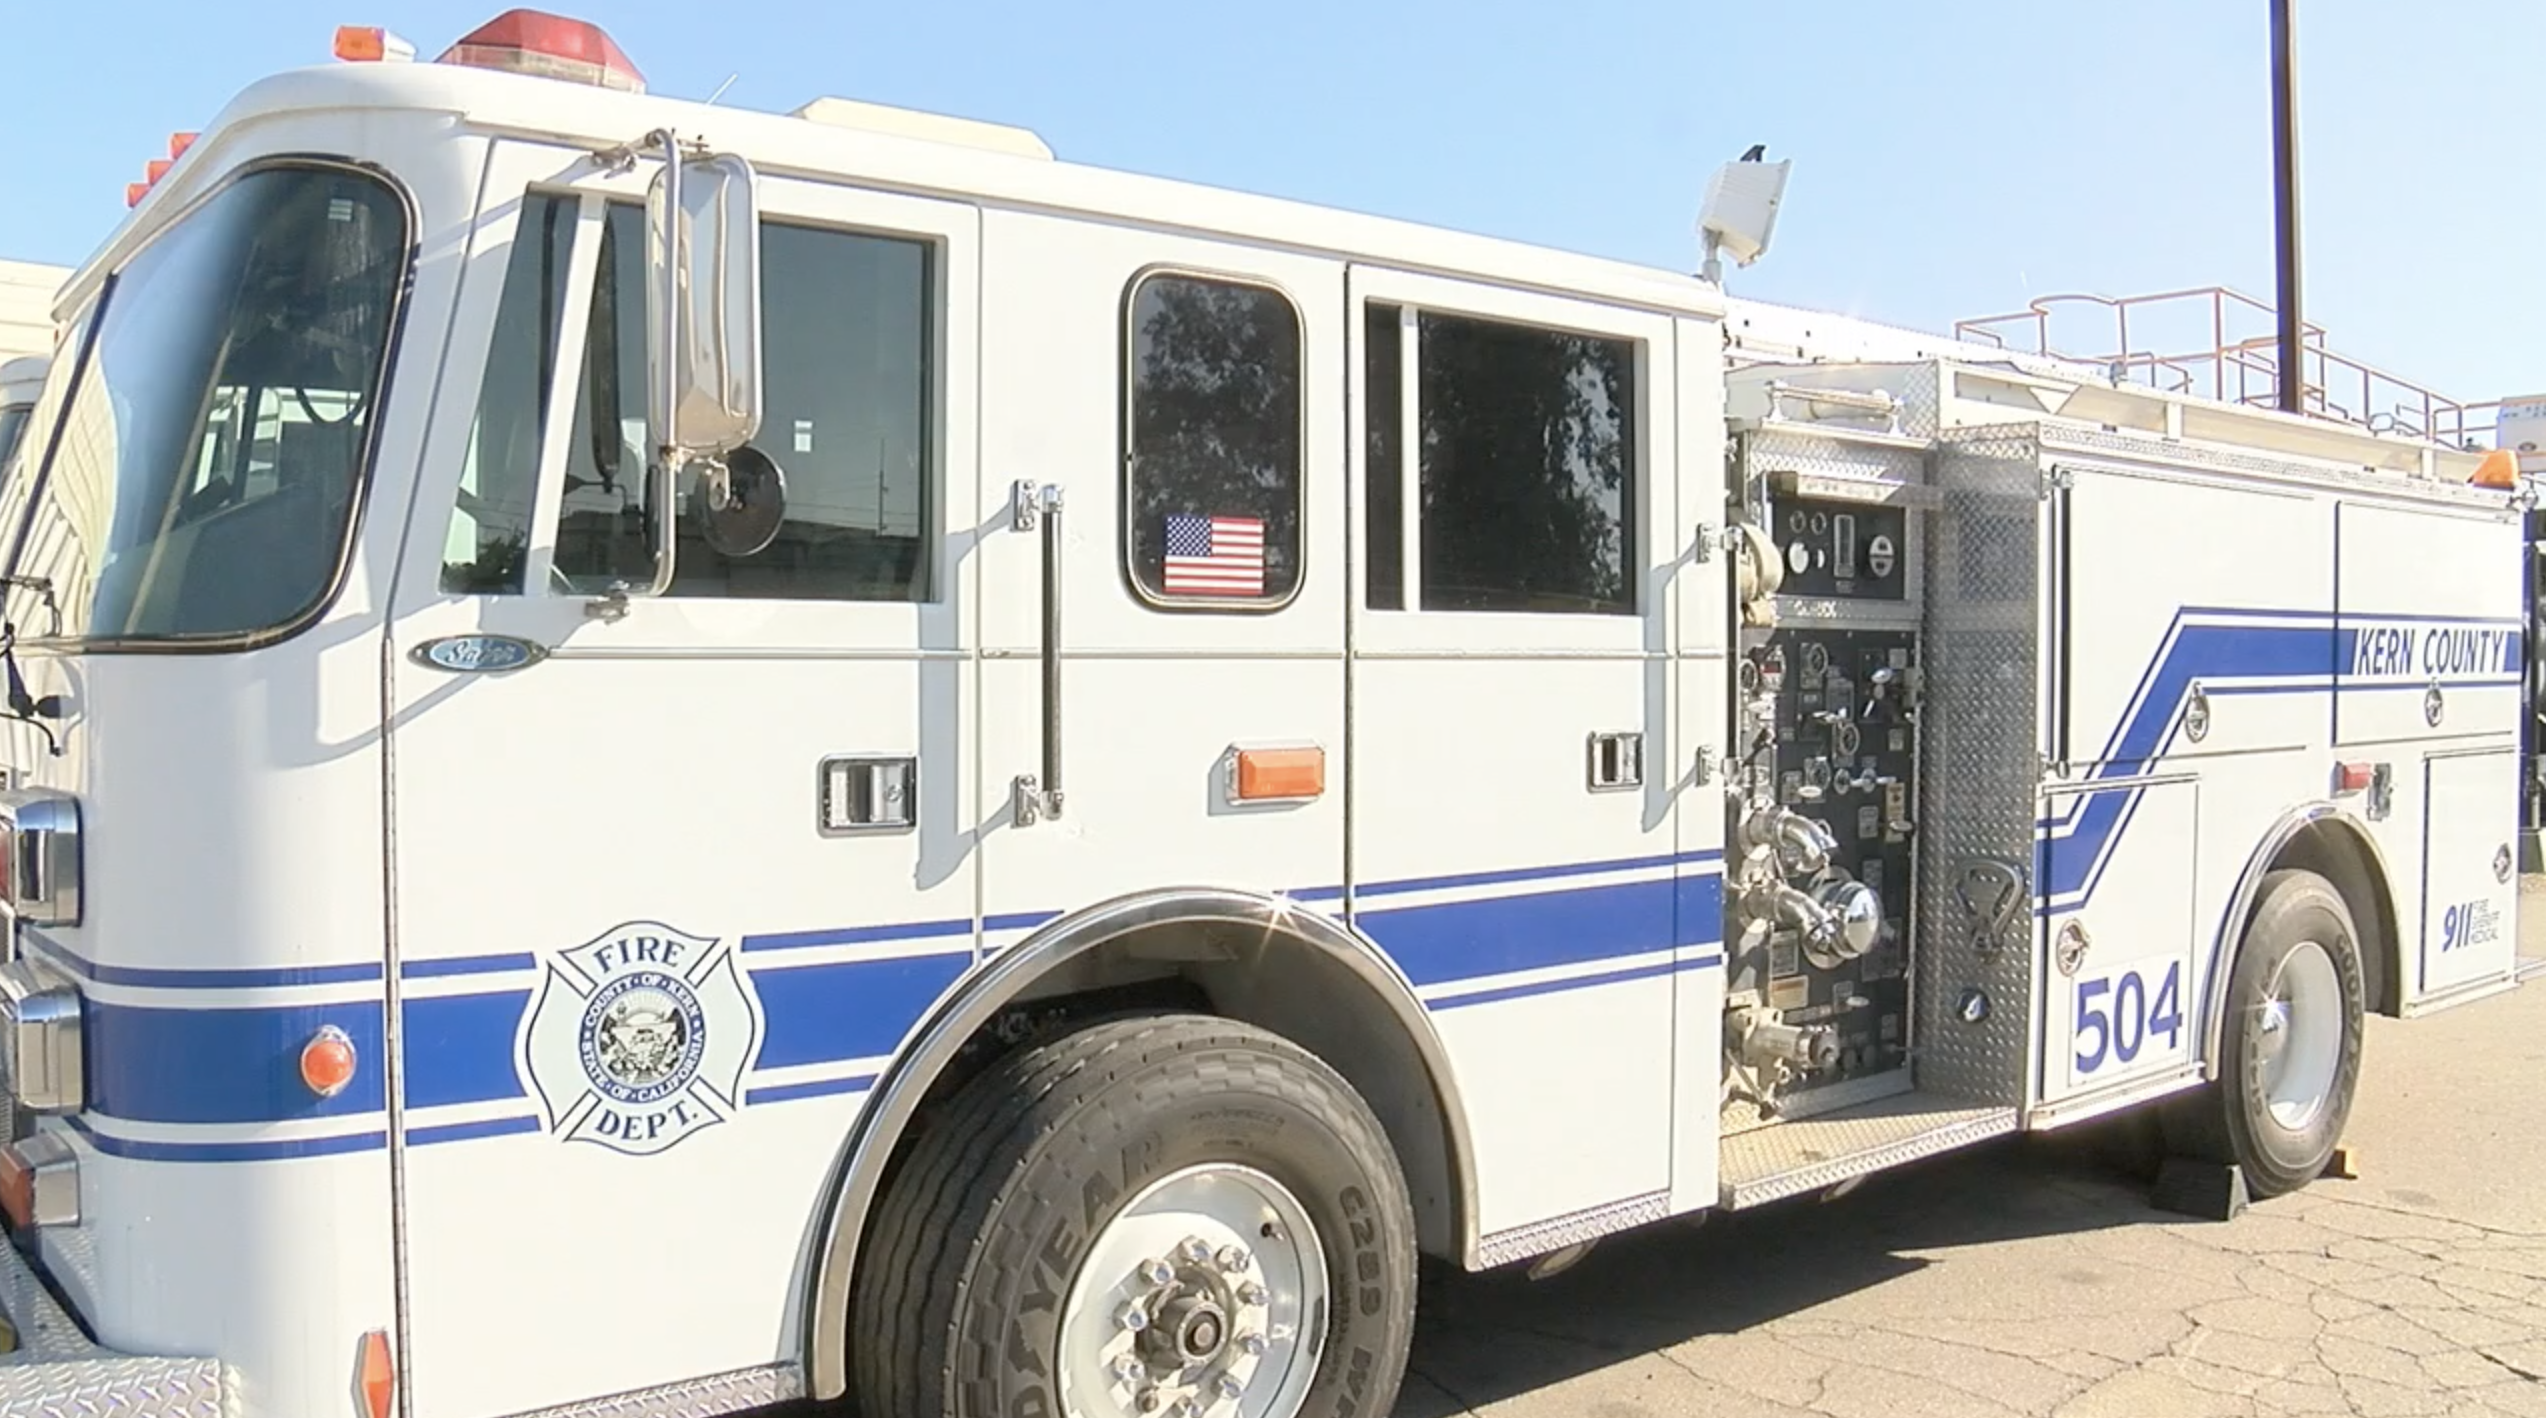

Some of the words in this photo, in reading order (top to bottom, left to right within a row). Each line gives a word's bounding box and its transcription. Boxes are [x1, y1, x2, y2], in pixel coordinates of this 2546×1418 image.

[2357, 628, 2415, 675] KERN
[2423, 628, 2505, 674] COUNTY
[2442, 903, 2473, 953] 911
[593, 936, 686, 974] FIRE
[584, 975, 634, 1027] COUNTY
[641, 973, 663, 987] OF
[667, 980, 701, 1017] KERN
[2075, 960, 2183, 1073] 504
[581, 1041, 607, 1087] STATE
[610, 1085, 633, 1100] OF
[636, 1030, 703, 1101] CALIFORNIA
[595, 1099, 698, 1140] DEPT.
